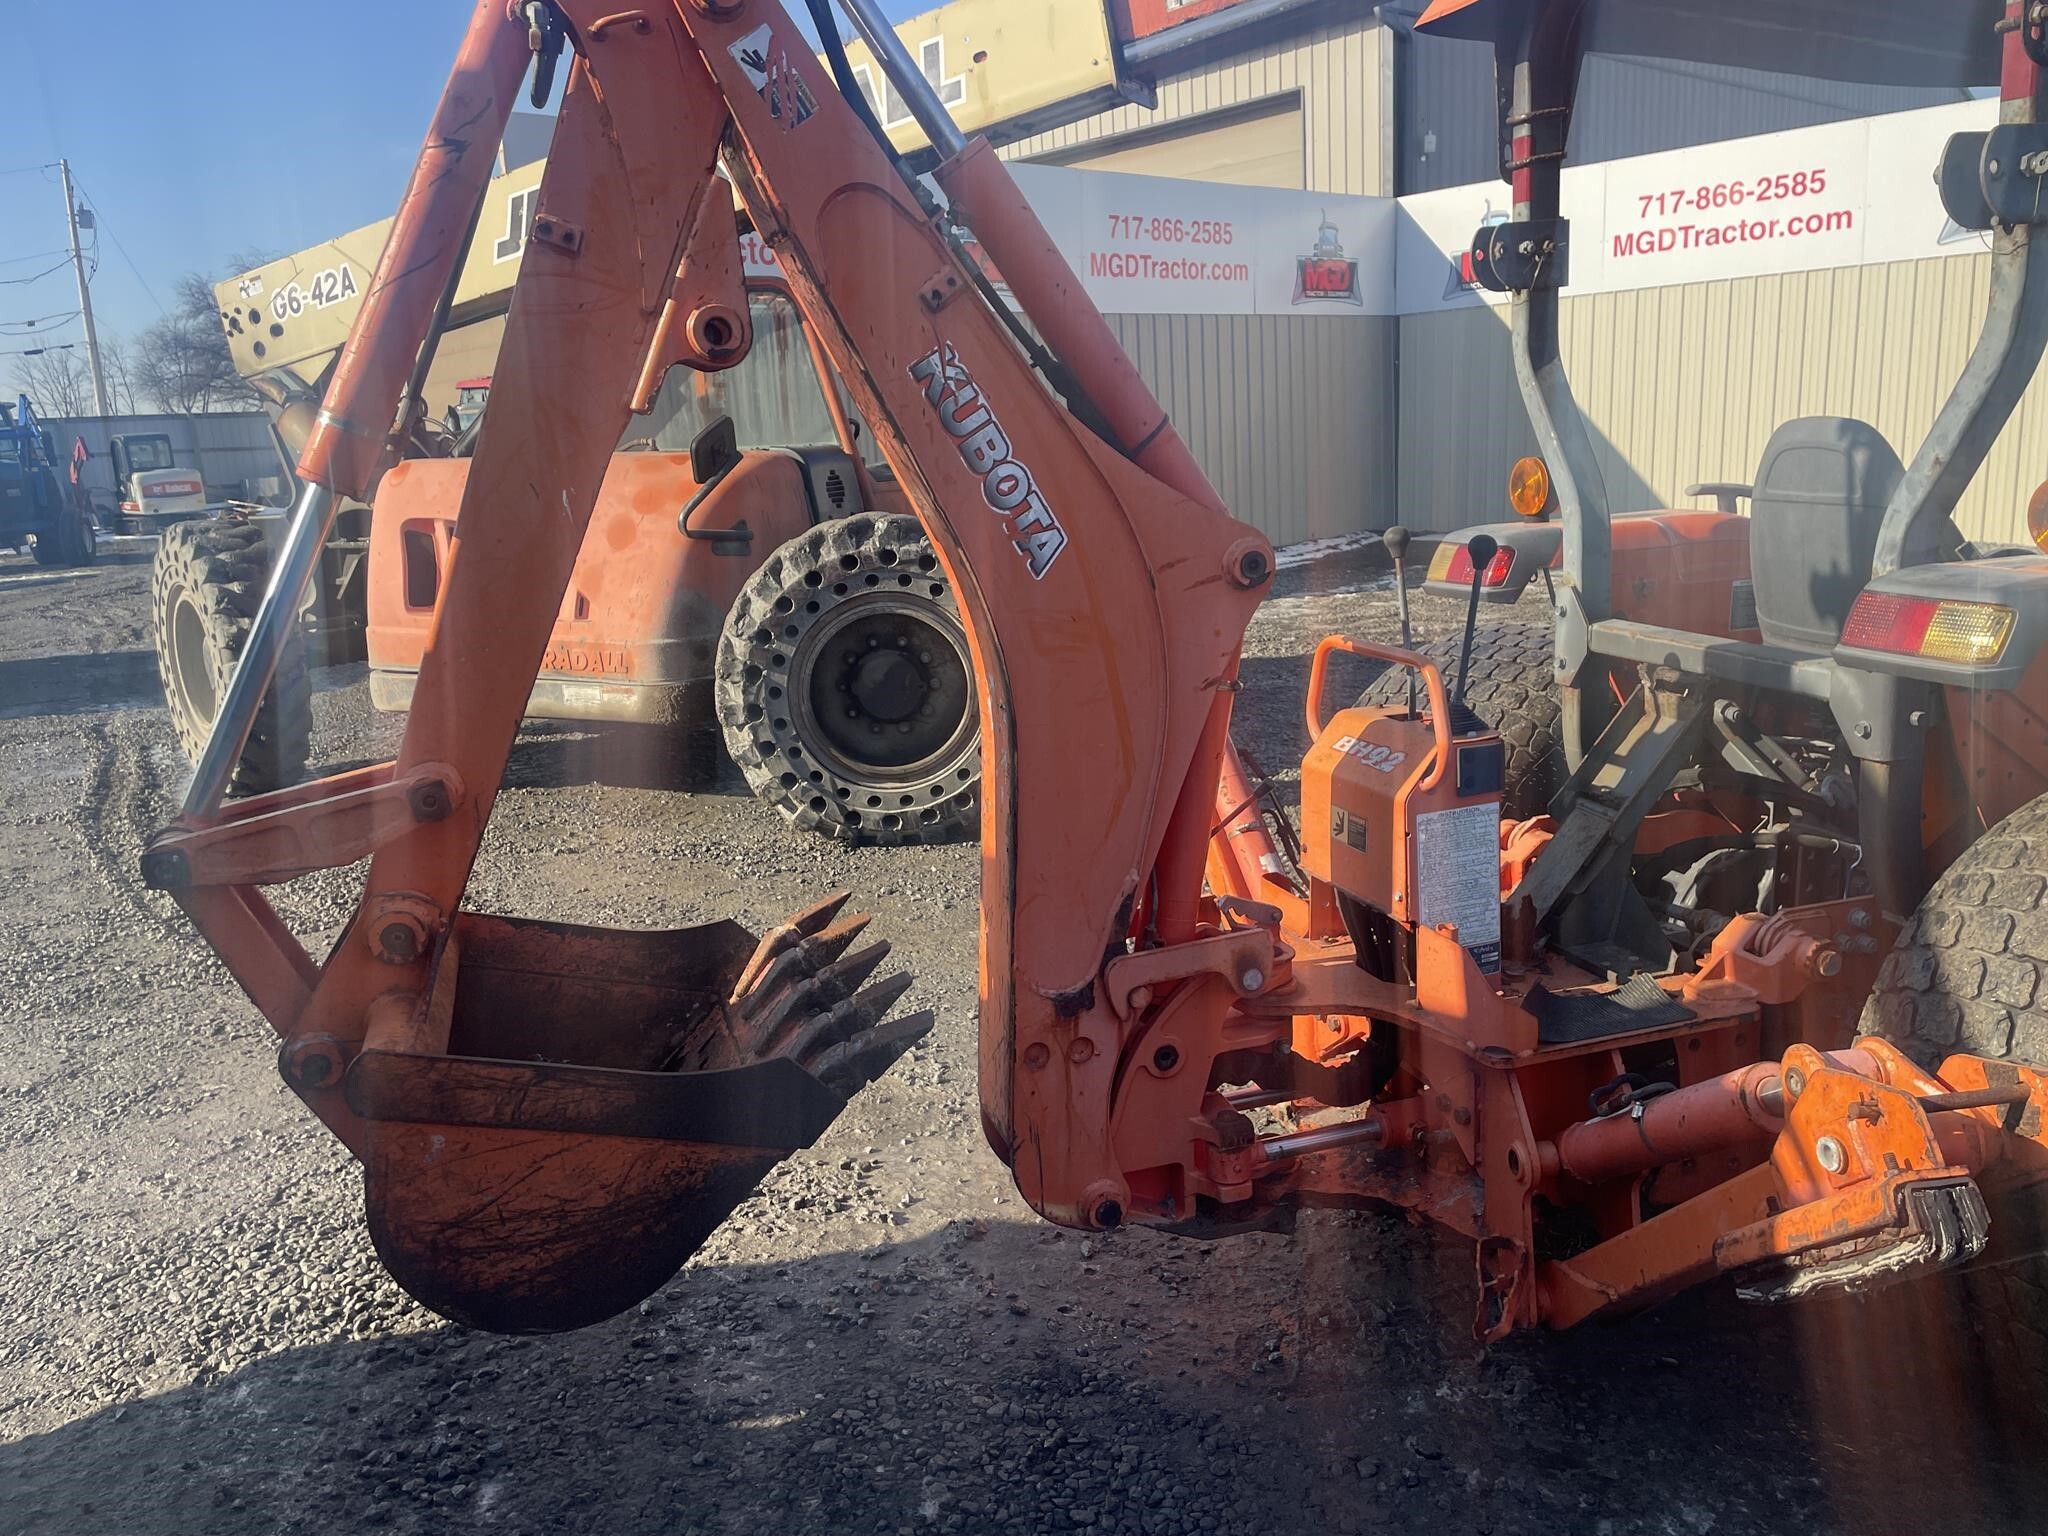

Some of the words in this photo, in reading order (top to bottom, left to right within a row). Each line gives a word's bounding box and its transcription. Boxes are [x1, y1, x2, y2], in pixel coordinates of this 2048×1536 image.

[1639, 168, 1826, 218] 717-866-2585
[1108, 214, 1233, 245] 717-866-2585
[1612, 209, 1853, 258] MGDTractor.com
[1090, 252, 1249, 281] MGDTractor.com
[272, 264, 357, 321] G6-42A
[907, 341, 1068, 580] KUBOTA
[1331, 735, 1407, 774] BH92
